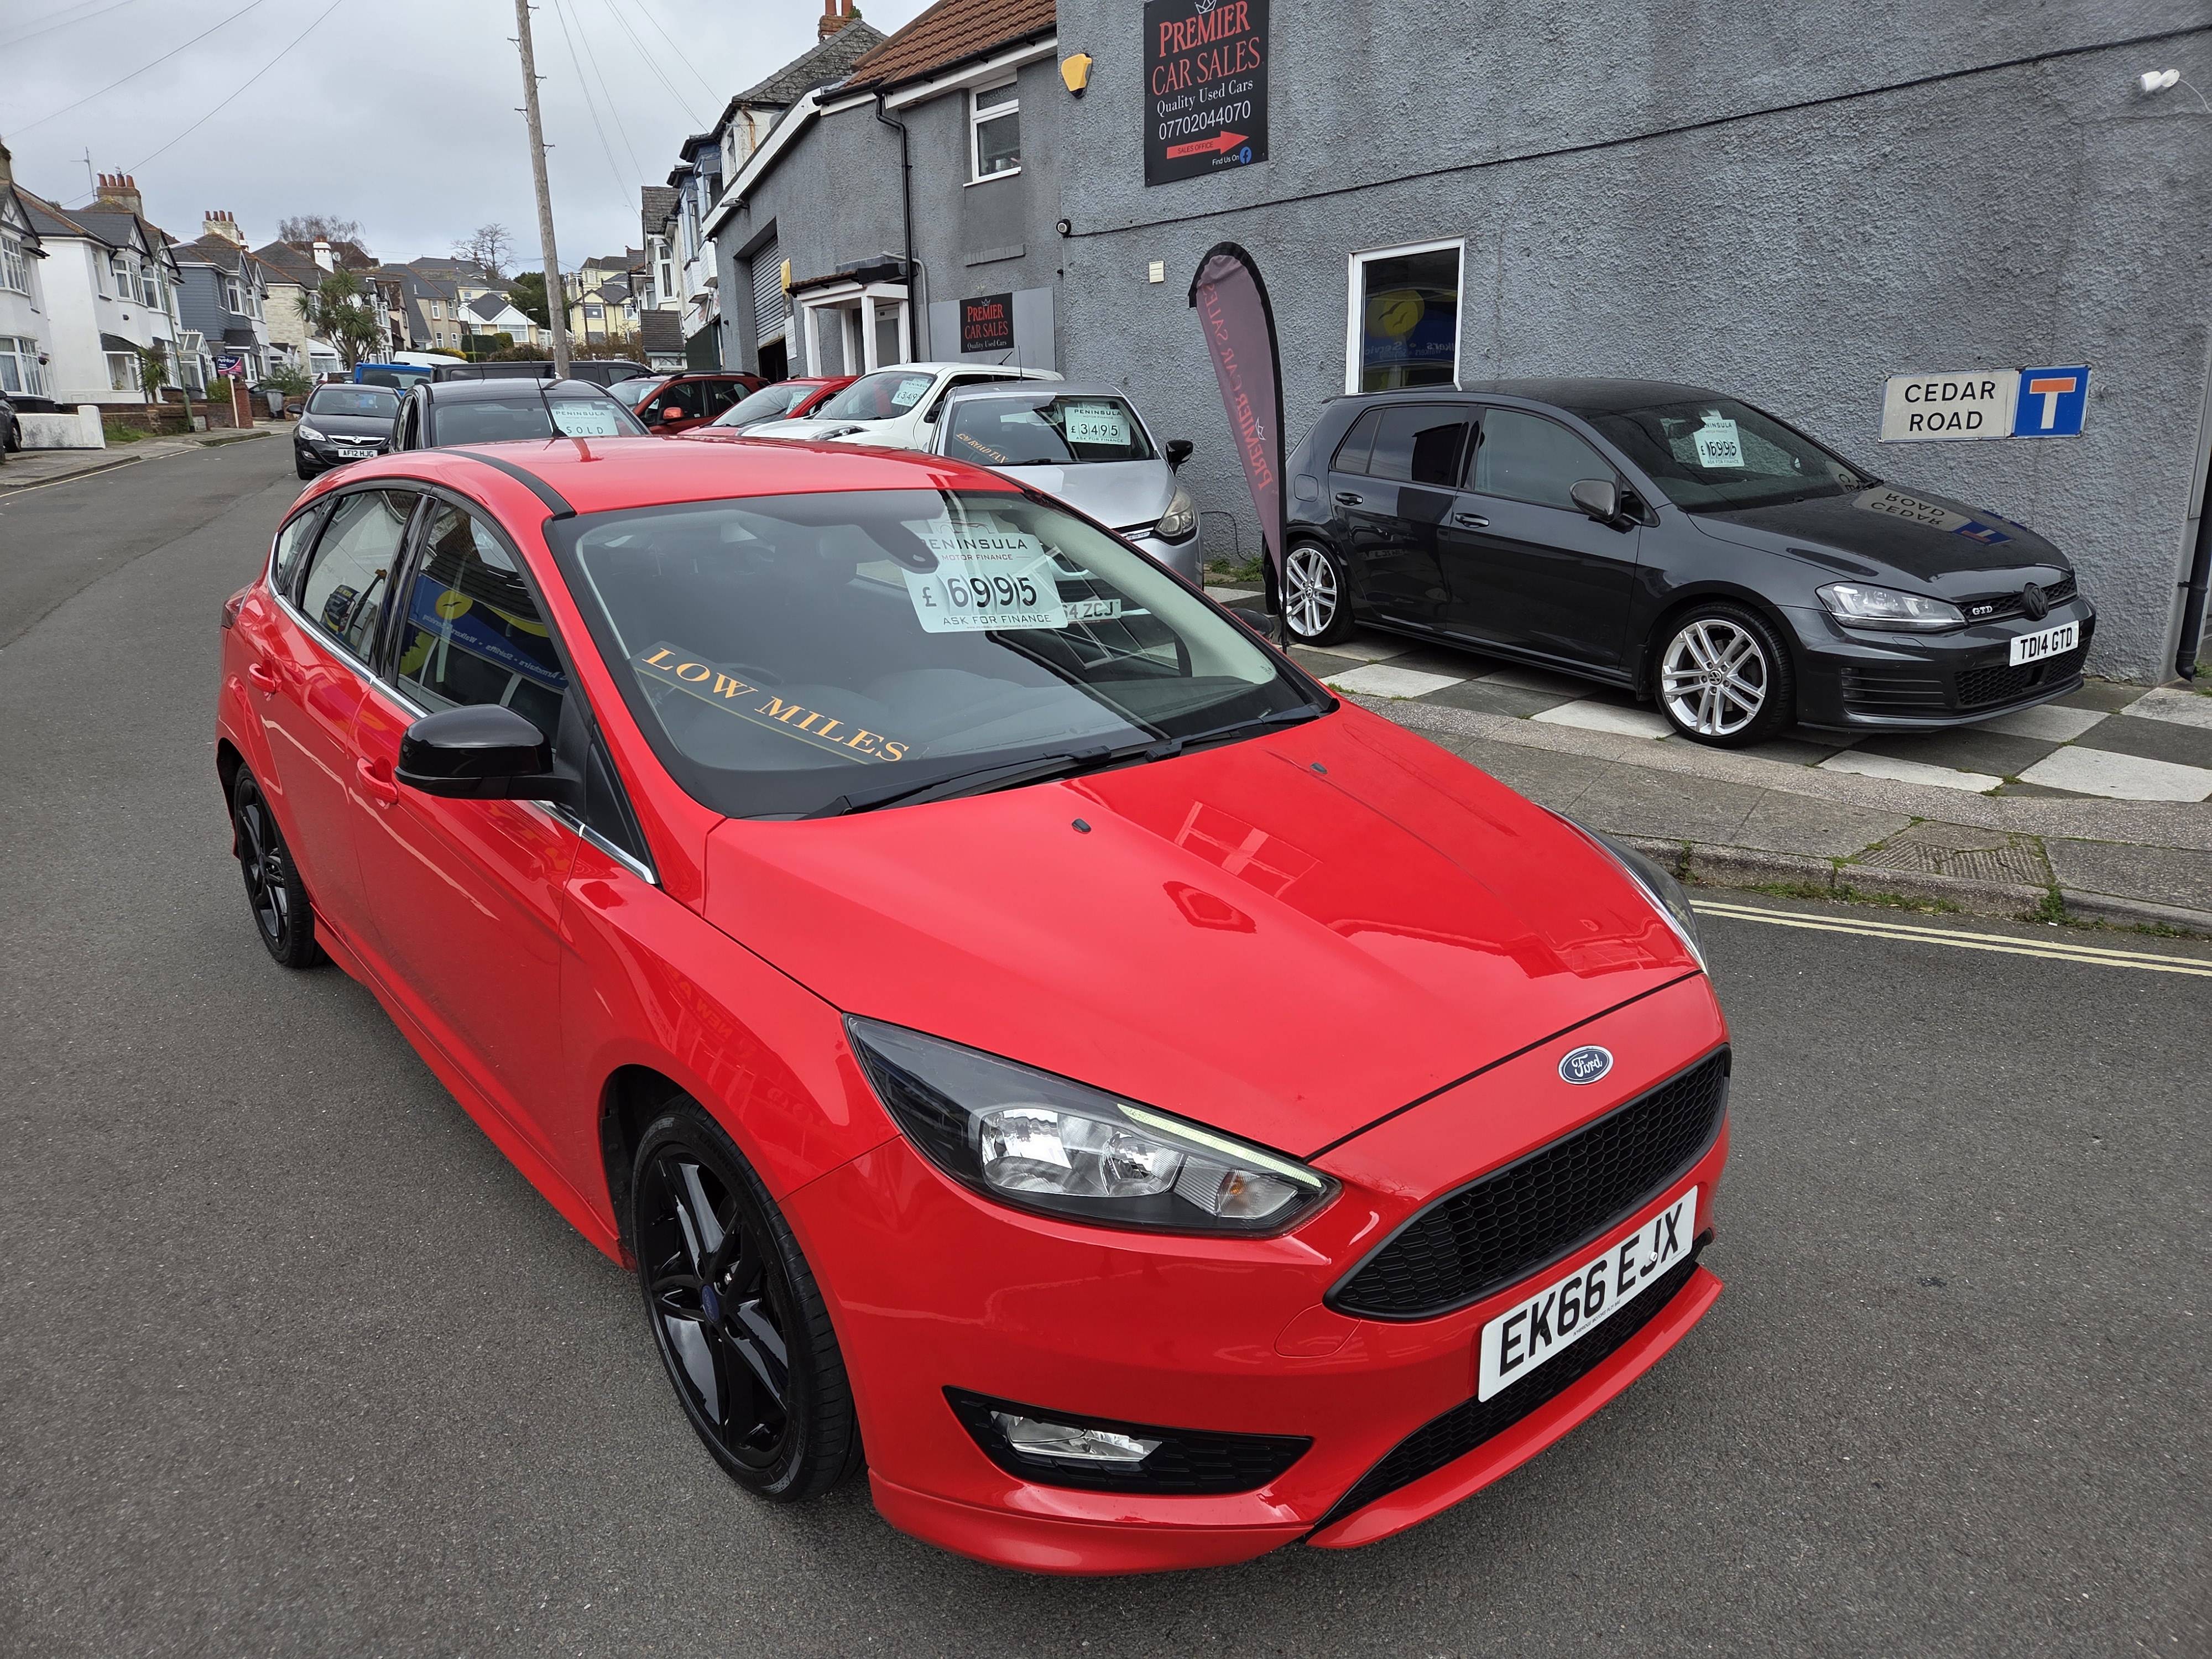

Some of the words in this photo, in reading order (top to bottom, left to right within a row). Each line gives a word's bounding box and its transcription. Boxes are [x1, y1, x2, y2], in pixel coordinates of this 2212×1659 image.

[1160, 1, 1250, 57] PREMIER
[1152, 59, 1192, 96] CAR
[1197, 36, 1260, 84] SALES
[1157, 95, 1196, 117] Quality
[1199, 83, 1225, 103] Used
[1229, 80, 1253, 95] Cars
[1159, 100, 1251, 140] 07702044070
[1177, 145, 1193, 154] SALES
[1194, 141, 1214, 150] OFFICE
[1212, 158, 1223, 166] Find
[967, 304, 1004, 322] PREMIER
[965, 324, 981, 340] CAR
[983, 321, 1009, 337] SALES
[967, 342, 983, 351] Quality
[1905, 380, 1996, 403] CEDAR
[566, 426, 604, 434] SOLD
[1081, 424, 1118, 436] 3495
[1909, 410, 1983, 432] ROAD
[968, 440, 992, 453] ROAD
[989, 451, 1009, 463] TAX
[924, 539, 1028, 549] ENINSULA
[947, 577, 1037, 608] 6995
[943, 617, 969, 625] ASK
[973, 615, 998, 624] FOR
[1001, 614, 1052, 624] FINANCE
[1083, 601, 1113, 618] ZCJ
[1972, 606, 1993, 615] GTD
[2020, 634, 2048, 660] TD14
[2052, 627, 2073, 651] GTD
[641, 648, 758, 698] LOW
[754, 696, 909, 762] MILES
[1571, 1053, 1603, 1077] Ford
[1500, 1259, 1608, 1378] EK66
[1616, 1202, 1683, 1298] EJX
